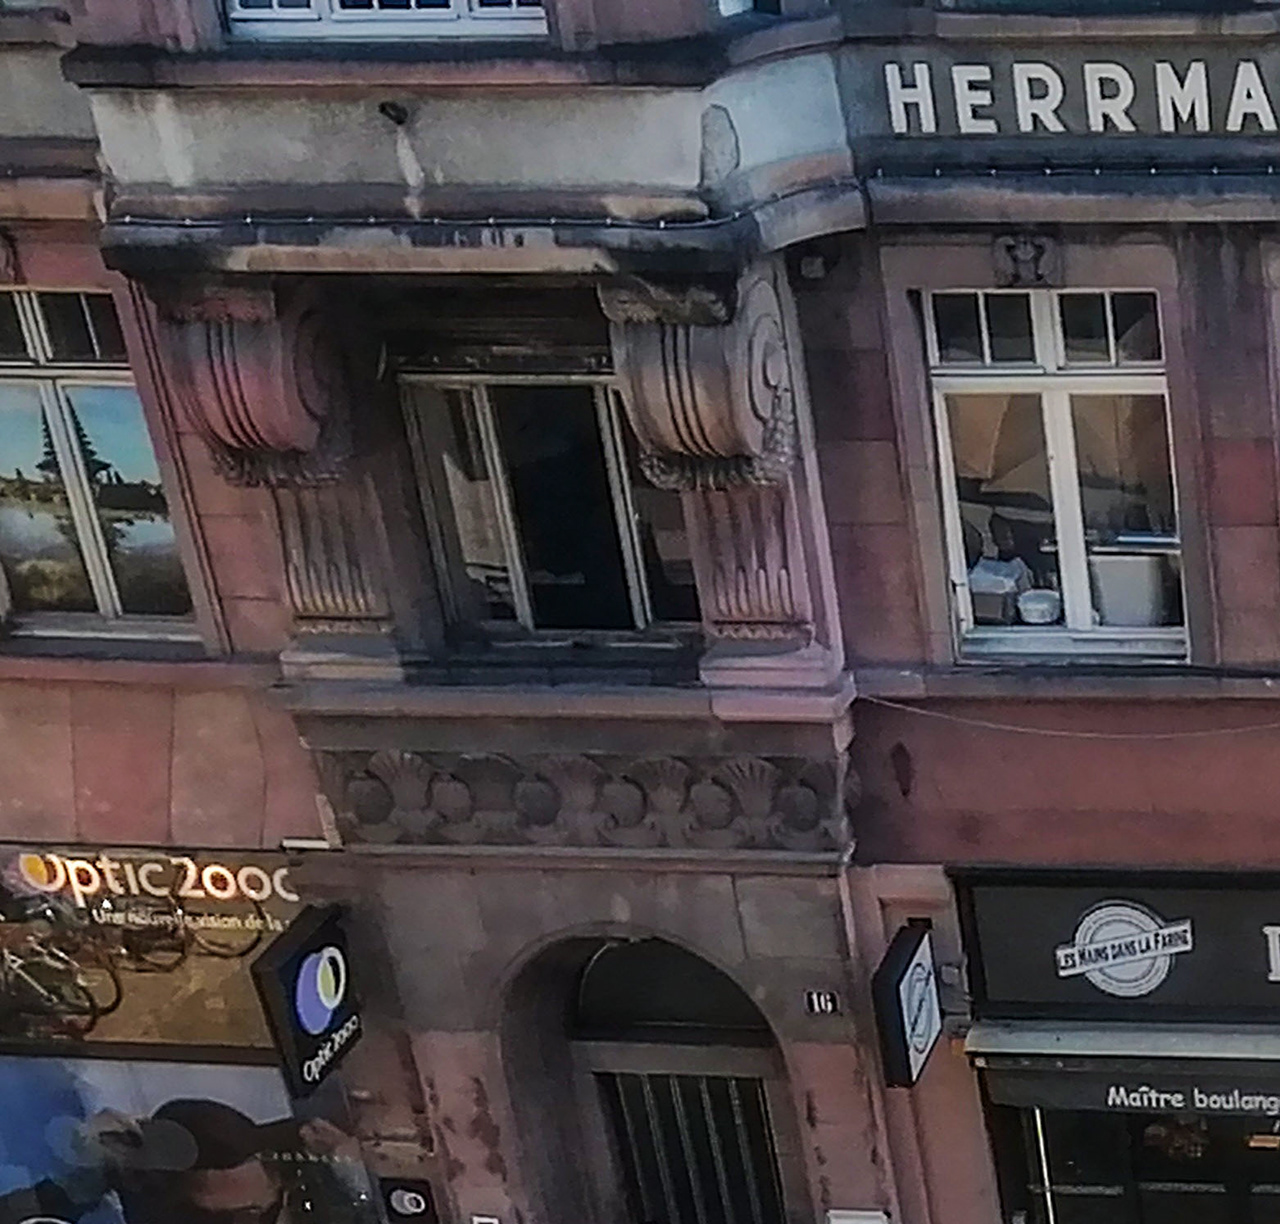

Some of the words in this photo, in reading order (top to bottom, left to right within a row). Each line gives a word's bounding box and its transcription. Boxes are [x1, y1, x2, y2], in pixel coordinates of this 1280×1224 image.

[1138, 936, 1152, 953] LA
[811, 991, 833, 1014] 16
[1106, 1085, 1185, 1109] Maître
